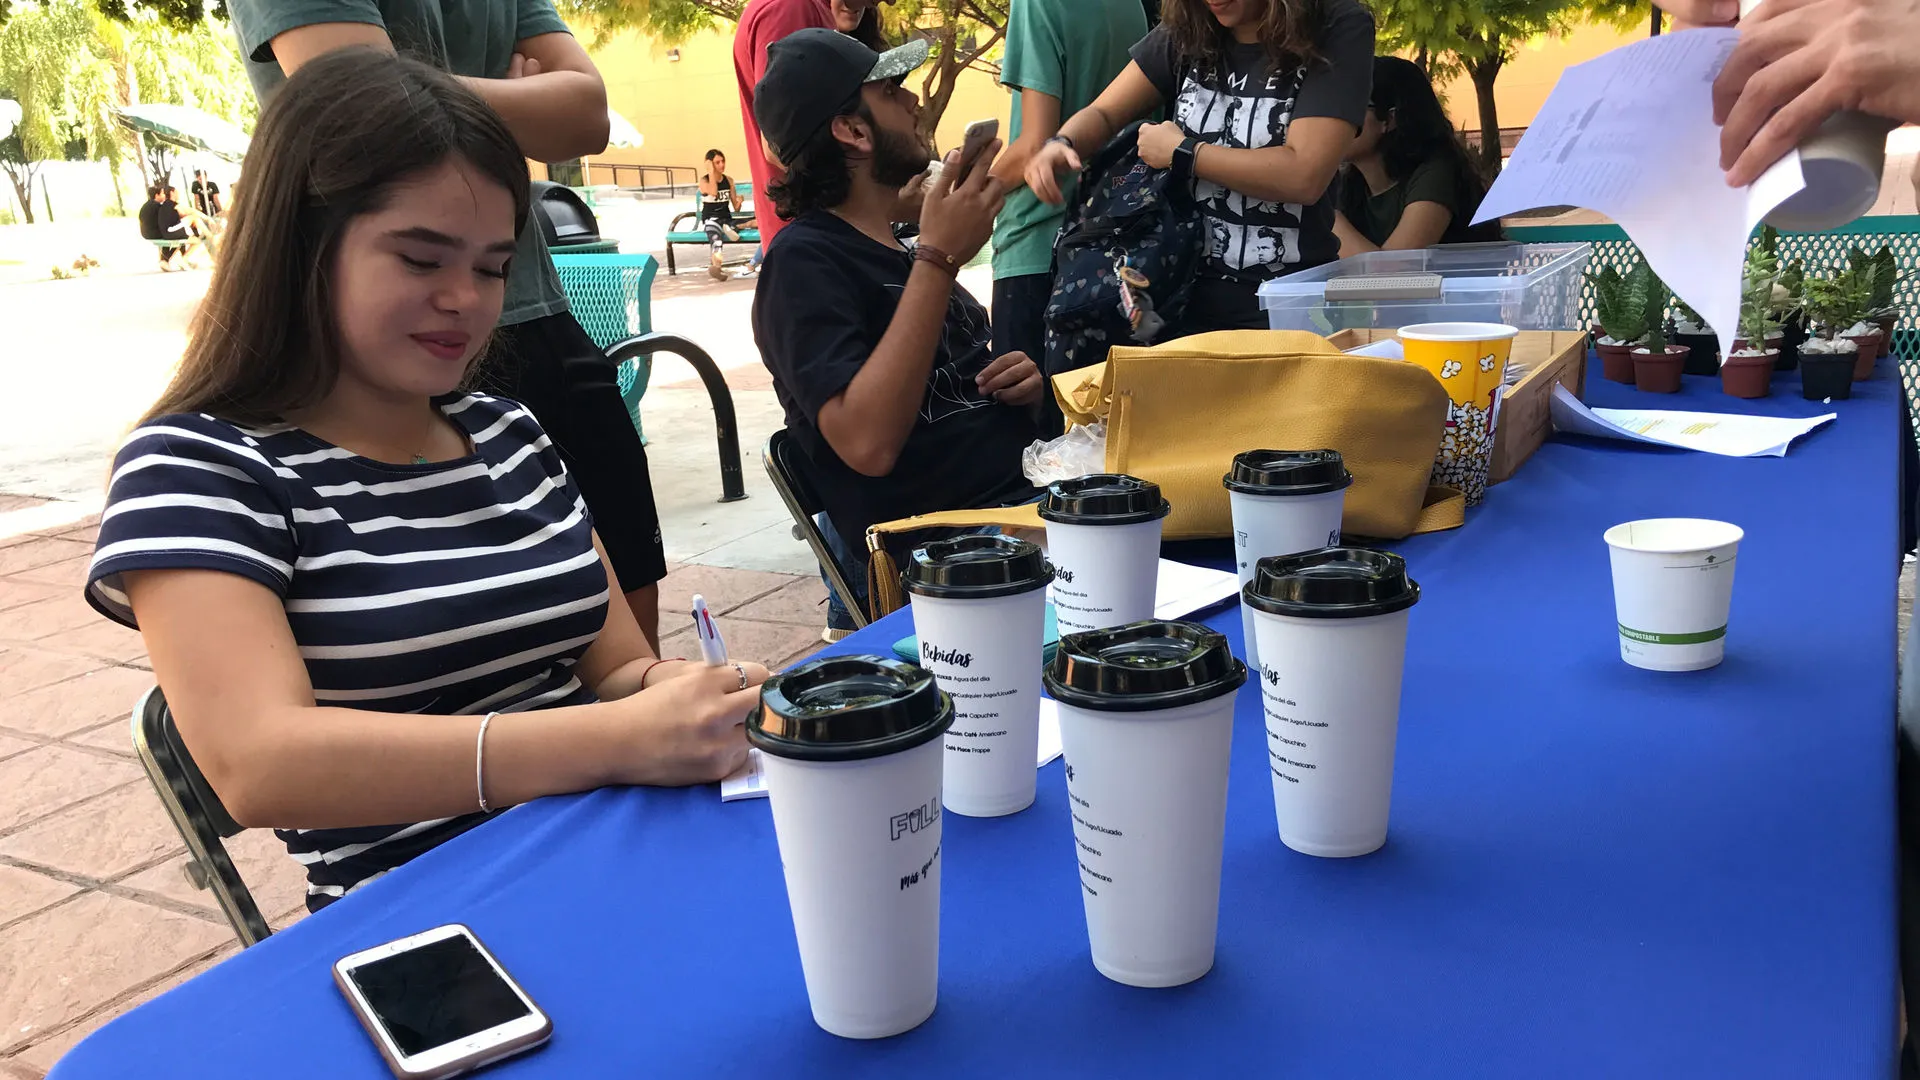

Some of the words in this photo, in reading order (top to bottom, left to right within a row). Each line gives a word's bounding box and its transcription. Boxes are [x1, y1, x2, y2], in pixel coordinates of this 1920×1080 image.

[922, 640, 974, 668] Bebidas
[1289, 717, 1329, 728] Jugo/Licuado
[978, 730, 1008, 738] Americano
[1279, 735, 1307, 748] Capuchino
[1287, 759, 1317, 769] Americano
